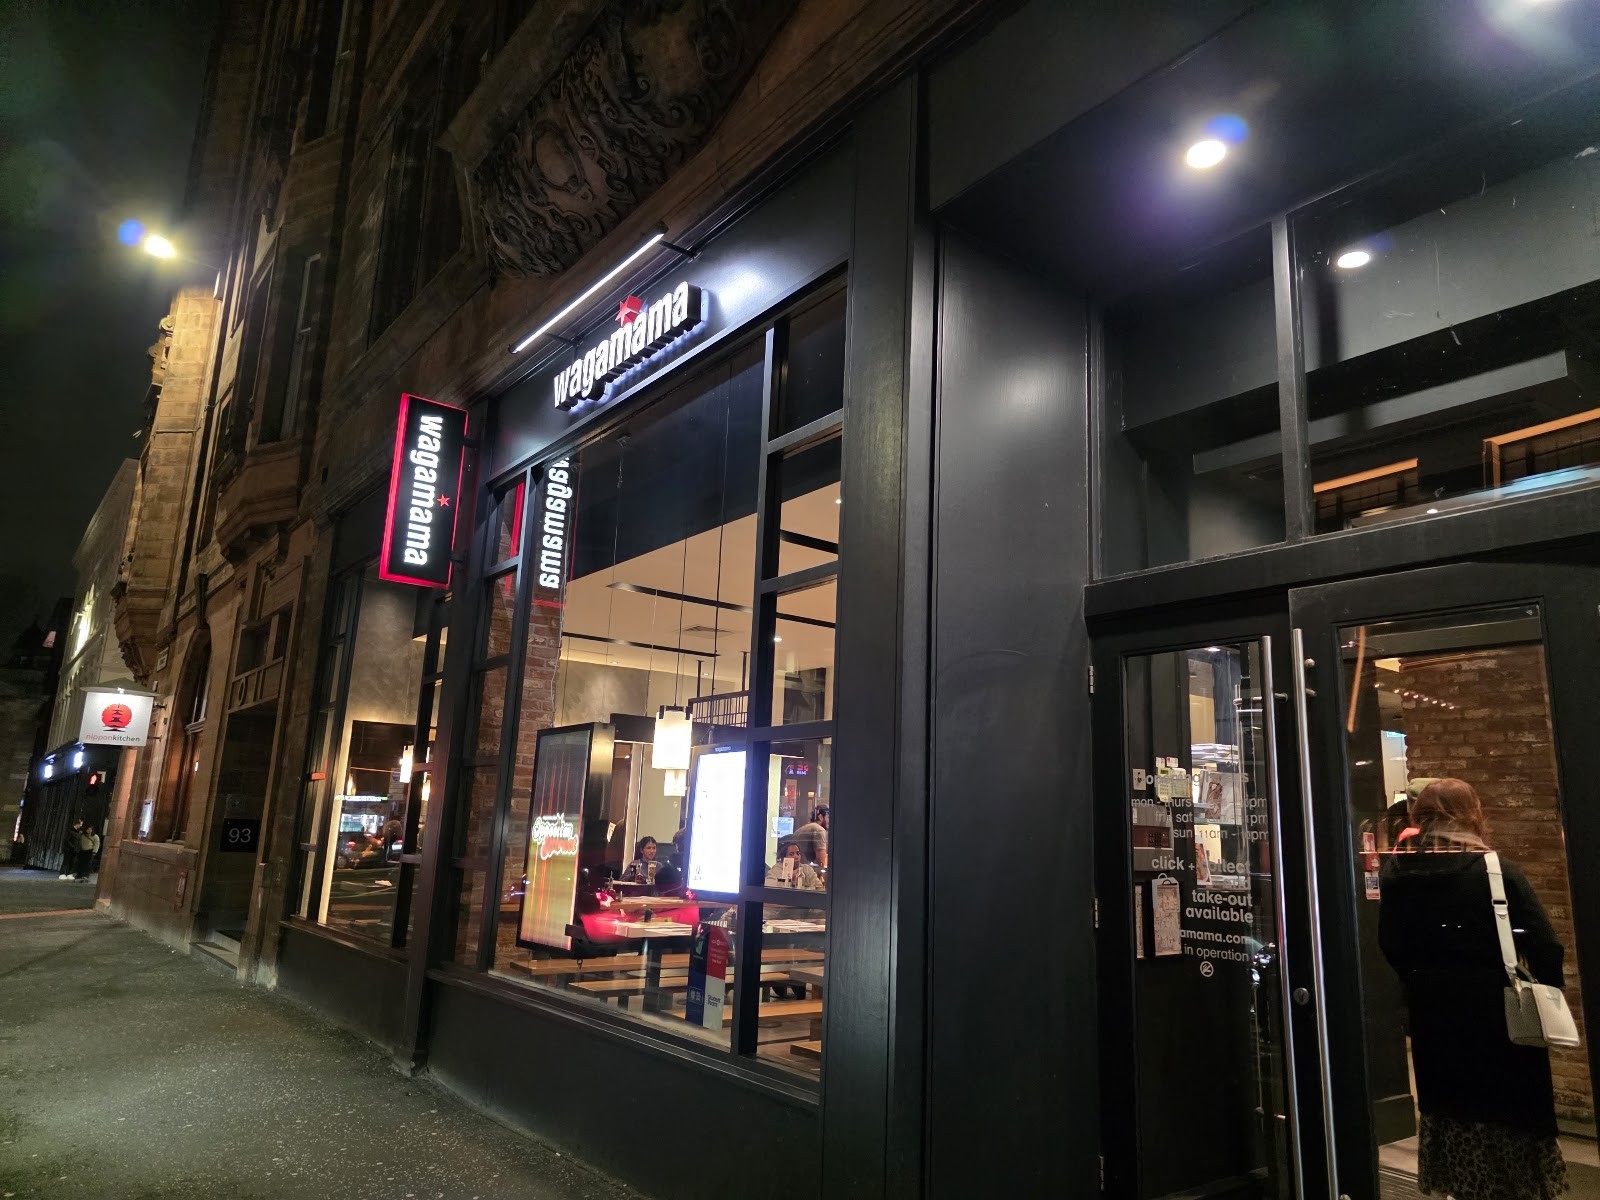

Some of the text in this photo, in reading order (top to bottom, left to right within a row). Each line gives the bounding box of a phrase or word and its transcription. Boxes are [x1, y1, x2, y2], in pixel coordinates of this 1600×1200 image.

[554, 281, 689, 409] wagamama
[403, 414, 444, 566] wagamama
[85, 733, 140, 742] nipponkitchen
[1131, 798, 1154, 807] mon
[1175, 812, 1193, 823] sat
[228, 827, 252, 843] 93
[1173, 830, 1193, 839] sun
[1199, 830, 1228, 839] 11am
[1151, 855, 1185, 870] click
[1188, 863, 1195, 871] +
[1192, 889, 1253, 907] take-out
[1185, 906, 1254, 924] available
[1183, 943, 1250, 962] in operation
